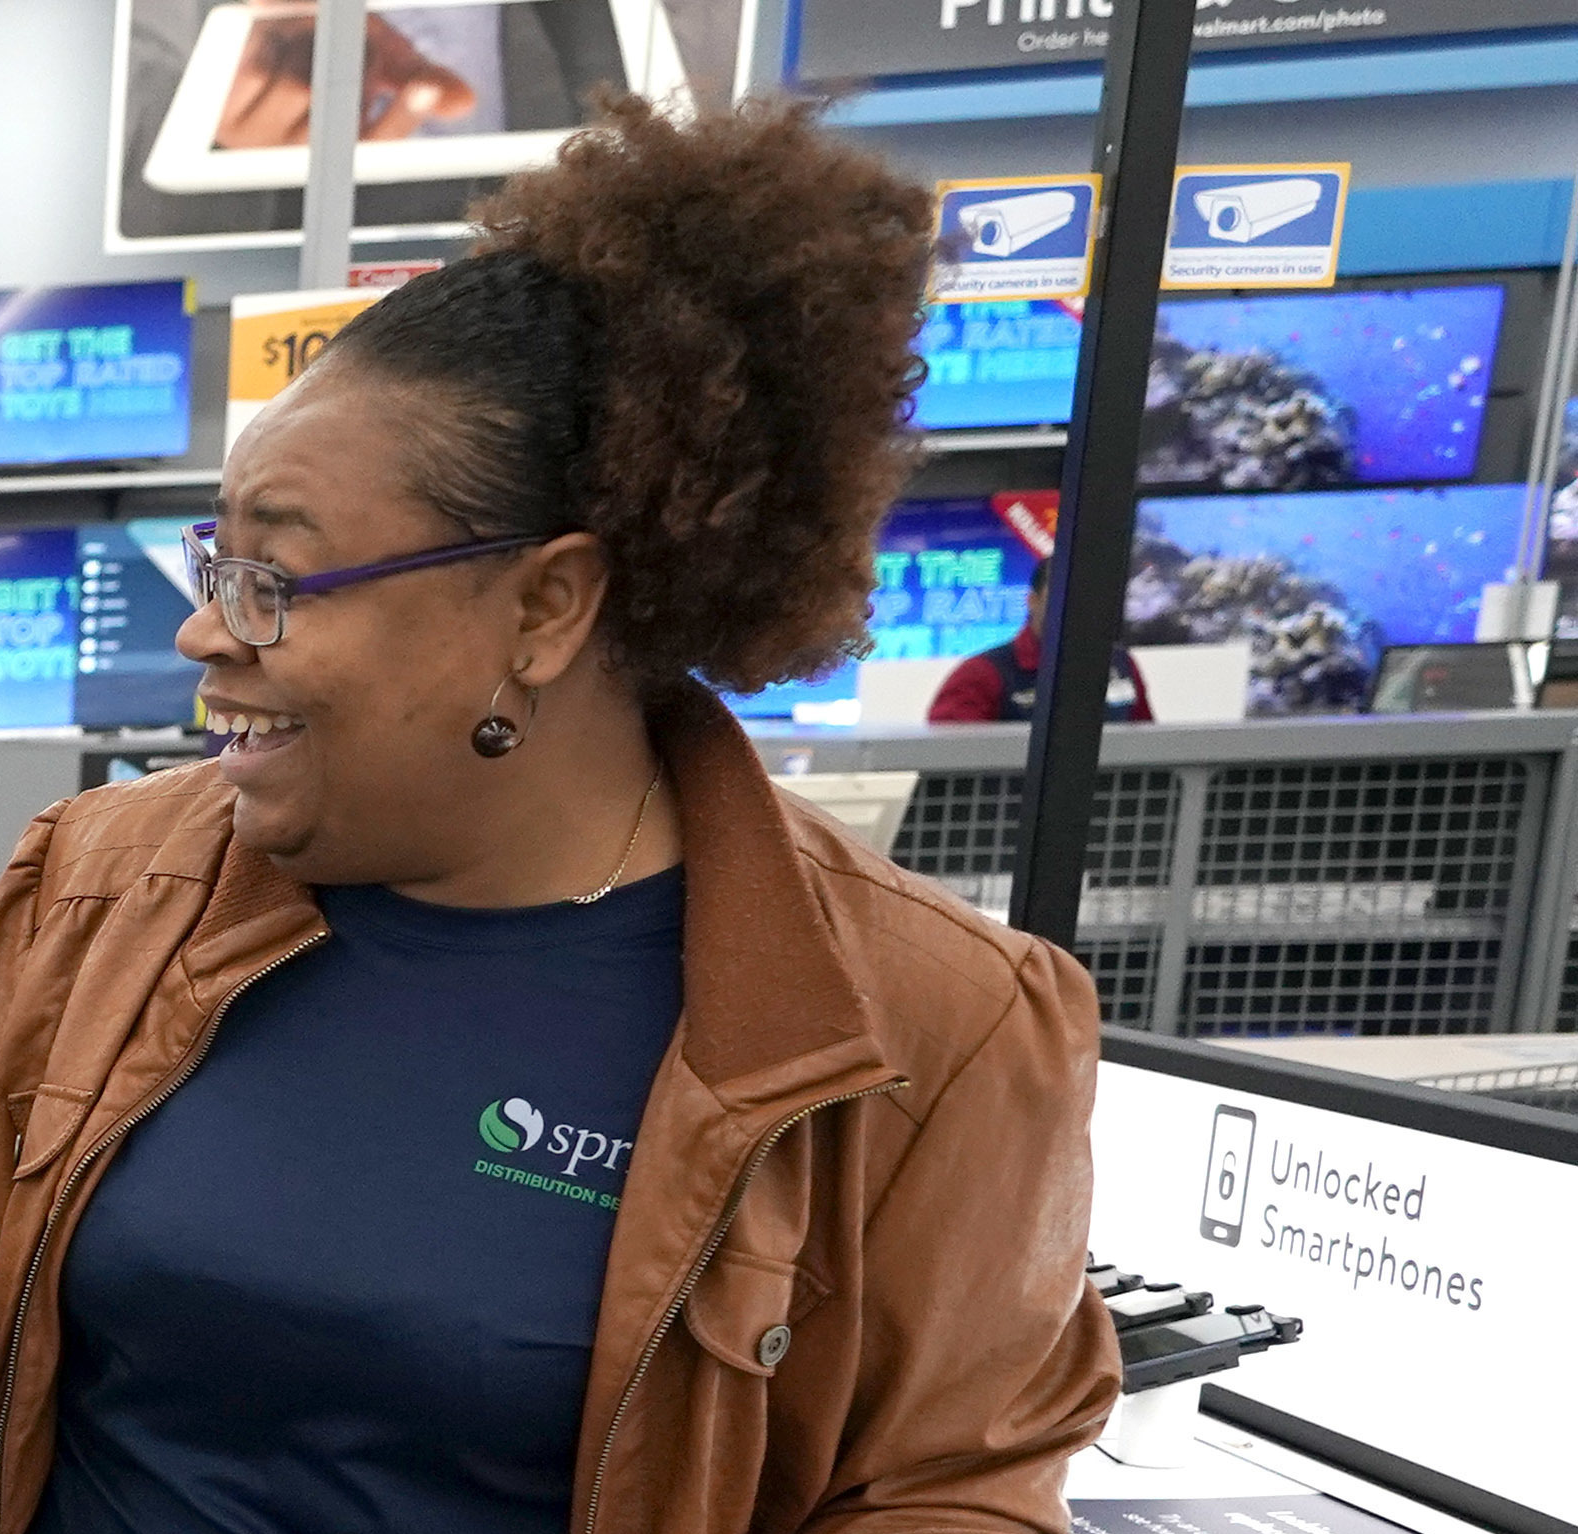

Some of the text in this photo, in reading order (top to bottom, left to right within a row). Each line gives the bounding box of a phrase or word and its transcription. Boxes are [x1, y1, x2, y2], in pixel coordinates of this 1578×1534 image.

[1170, 264, 1221, 277] Security
[1225, 264, 1280, 276] cameras
[1283, 262, 1295, 274] in
[548, 1124, 634, 1177] spr
[474, 1159, 595, 1204] DISTRIBUTION
[1271, 1140, 1426, 1222] Unlocked
[1261, 1204, 1484, 1311] Smartphones
